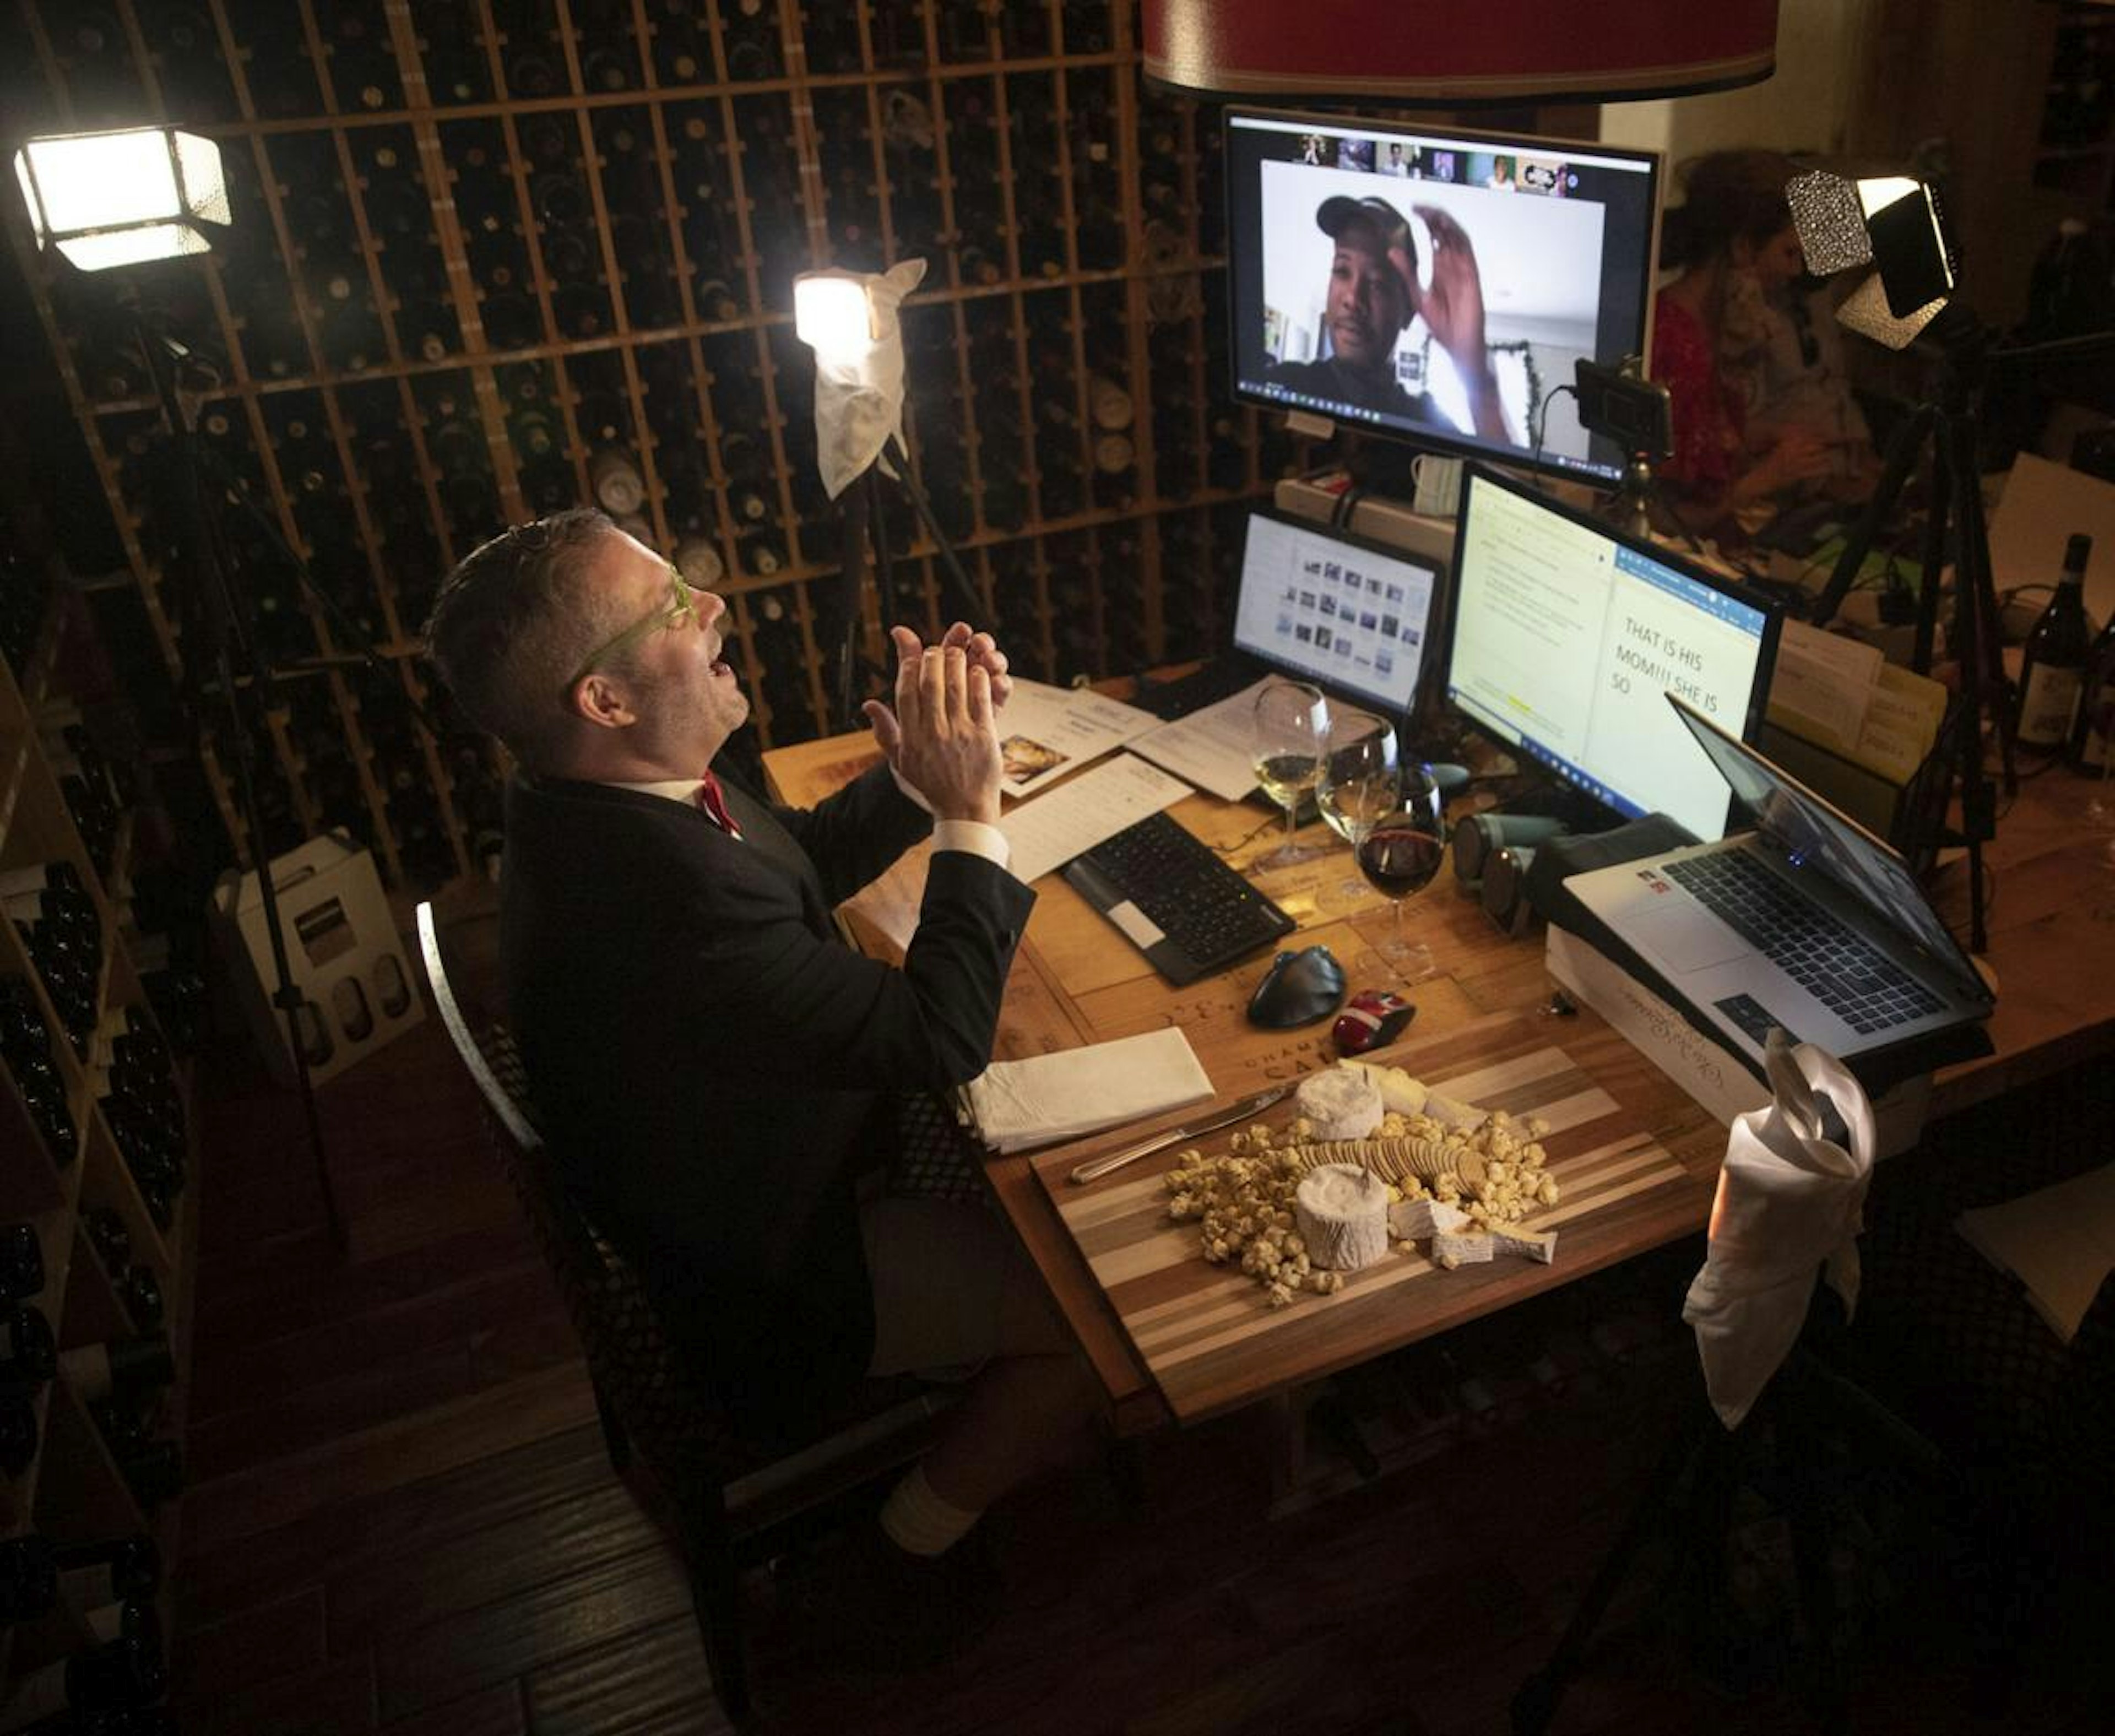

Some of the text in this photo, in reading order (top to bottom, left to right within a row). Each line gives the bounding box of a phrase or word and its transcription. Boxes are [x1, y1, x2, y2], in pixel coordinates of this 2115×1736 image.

[1626, 617, 1702, 671] THAT IS HIS
[1611, 673, 1630, 693] SO
[1617, 644, 1717, 712] MOM!!! SHE IS
